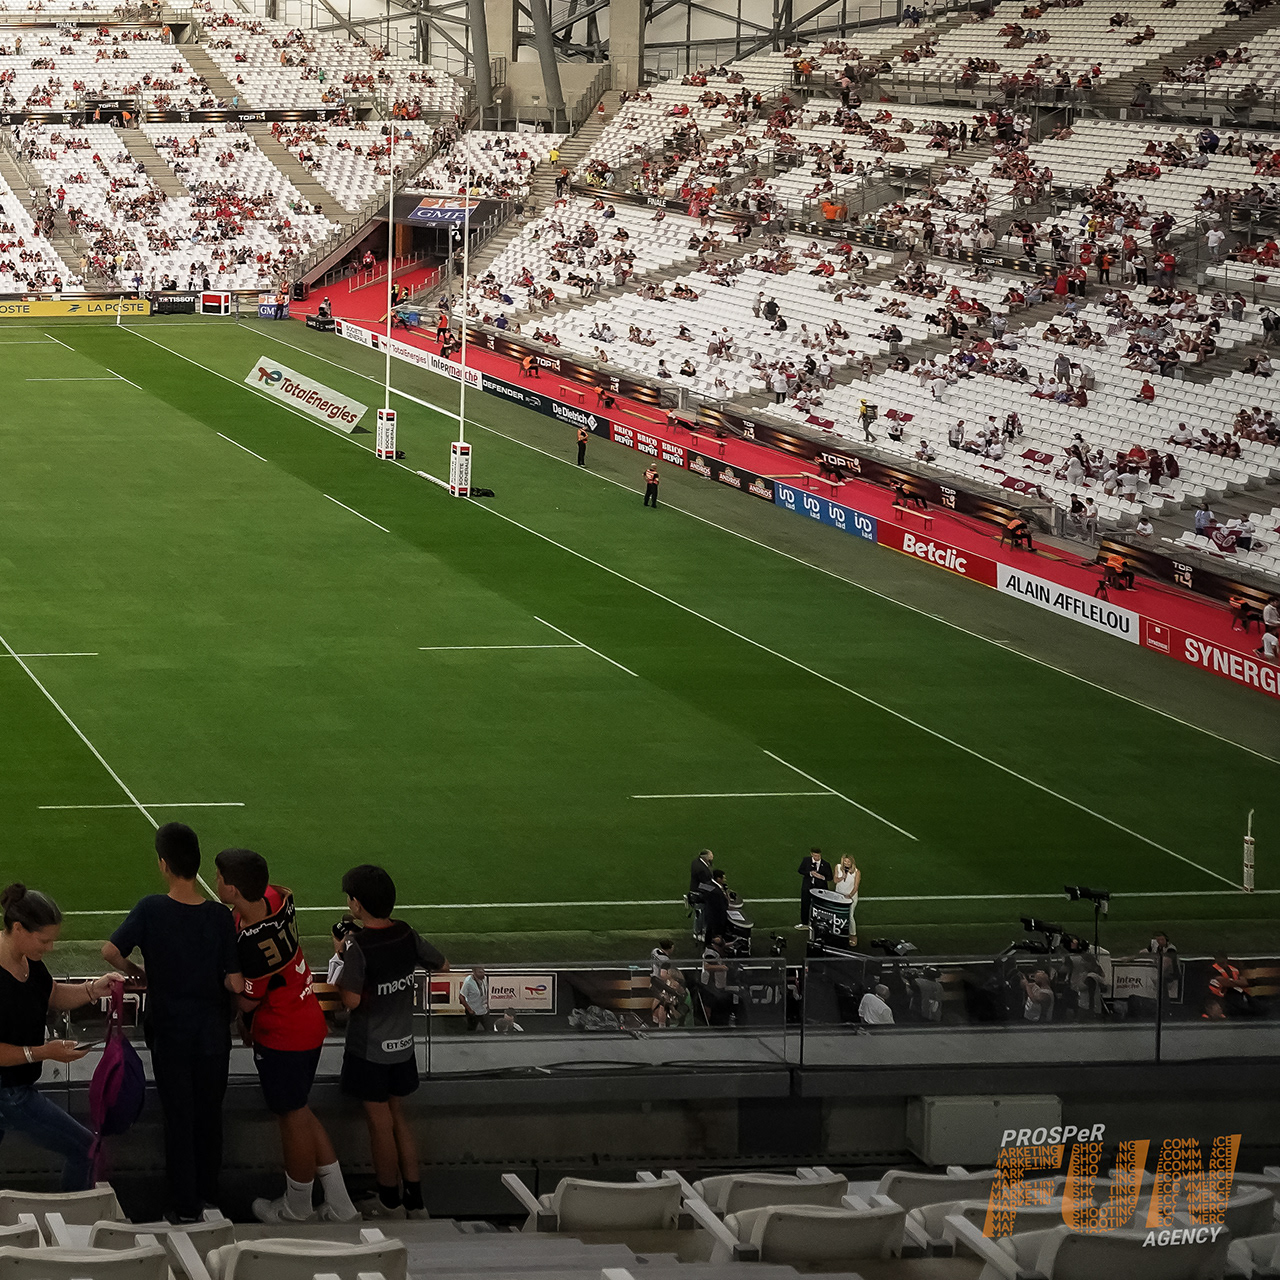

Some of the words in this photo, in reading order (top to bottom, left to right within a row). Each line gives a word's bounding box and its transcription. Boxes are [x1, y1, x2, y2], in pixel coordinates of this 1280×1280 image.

[647, 198, 668, 208] FINALE
[88, 304, 102, 313] LA
[104, 304, 144, 312] POSTE
[392, 344, 426, 364] TotalEnergies
[430, 356, 478, 384] Intermaché
[482, 378, 524, 401] DEFENDER
[279, 377, 358, 424] TotalEnergies
[562, 406, 588, 424] Dietrich
[614, 424, 633, 438] BRICO
[637, 433, 658, 447] BRICO
[662, 442, 684, 456] BRICO
[690, 461, 711, 476] ANDROS
[718, 472, 741, 488] ANDROS
[748, 484, 772, 500] ANDROS
[902, 532, 968, 573] Betclic
[1172, 560, 1193, 572] TOP
[1006, 574, 1050, 605] ALAIN
[1053, 592, 1130, 634] AFFLELOU
[1184, 637, 1280, 696] SYNERGI
